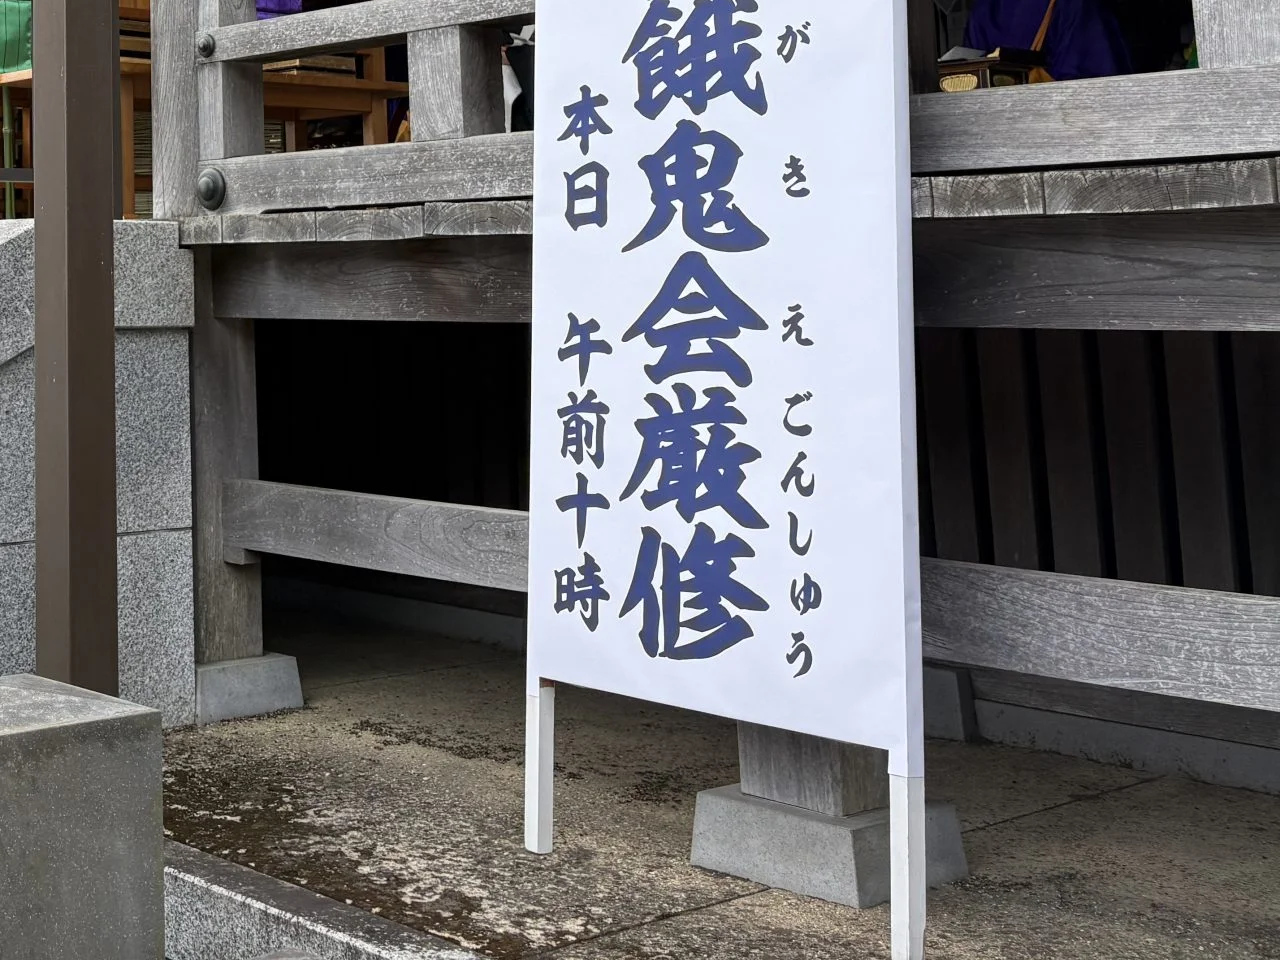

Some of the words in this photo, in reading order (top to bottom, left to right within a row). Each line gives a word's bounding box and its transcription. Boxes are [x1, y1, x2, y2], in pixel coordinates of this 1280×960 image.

[557, 85, 613, 231] 本日
[554, 312, 613, 633] 午前十時
